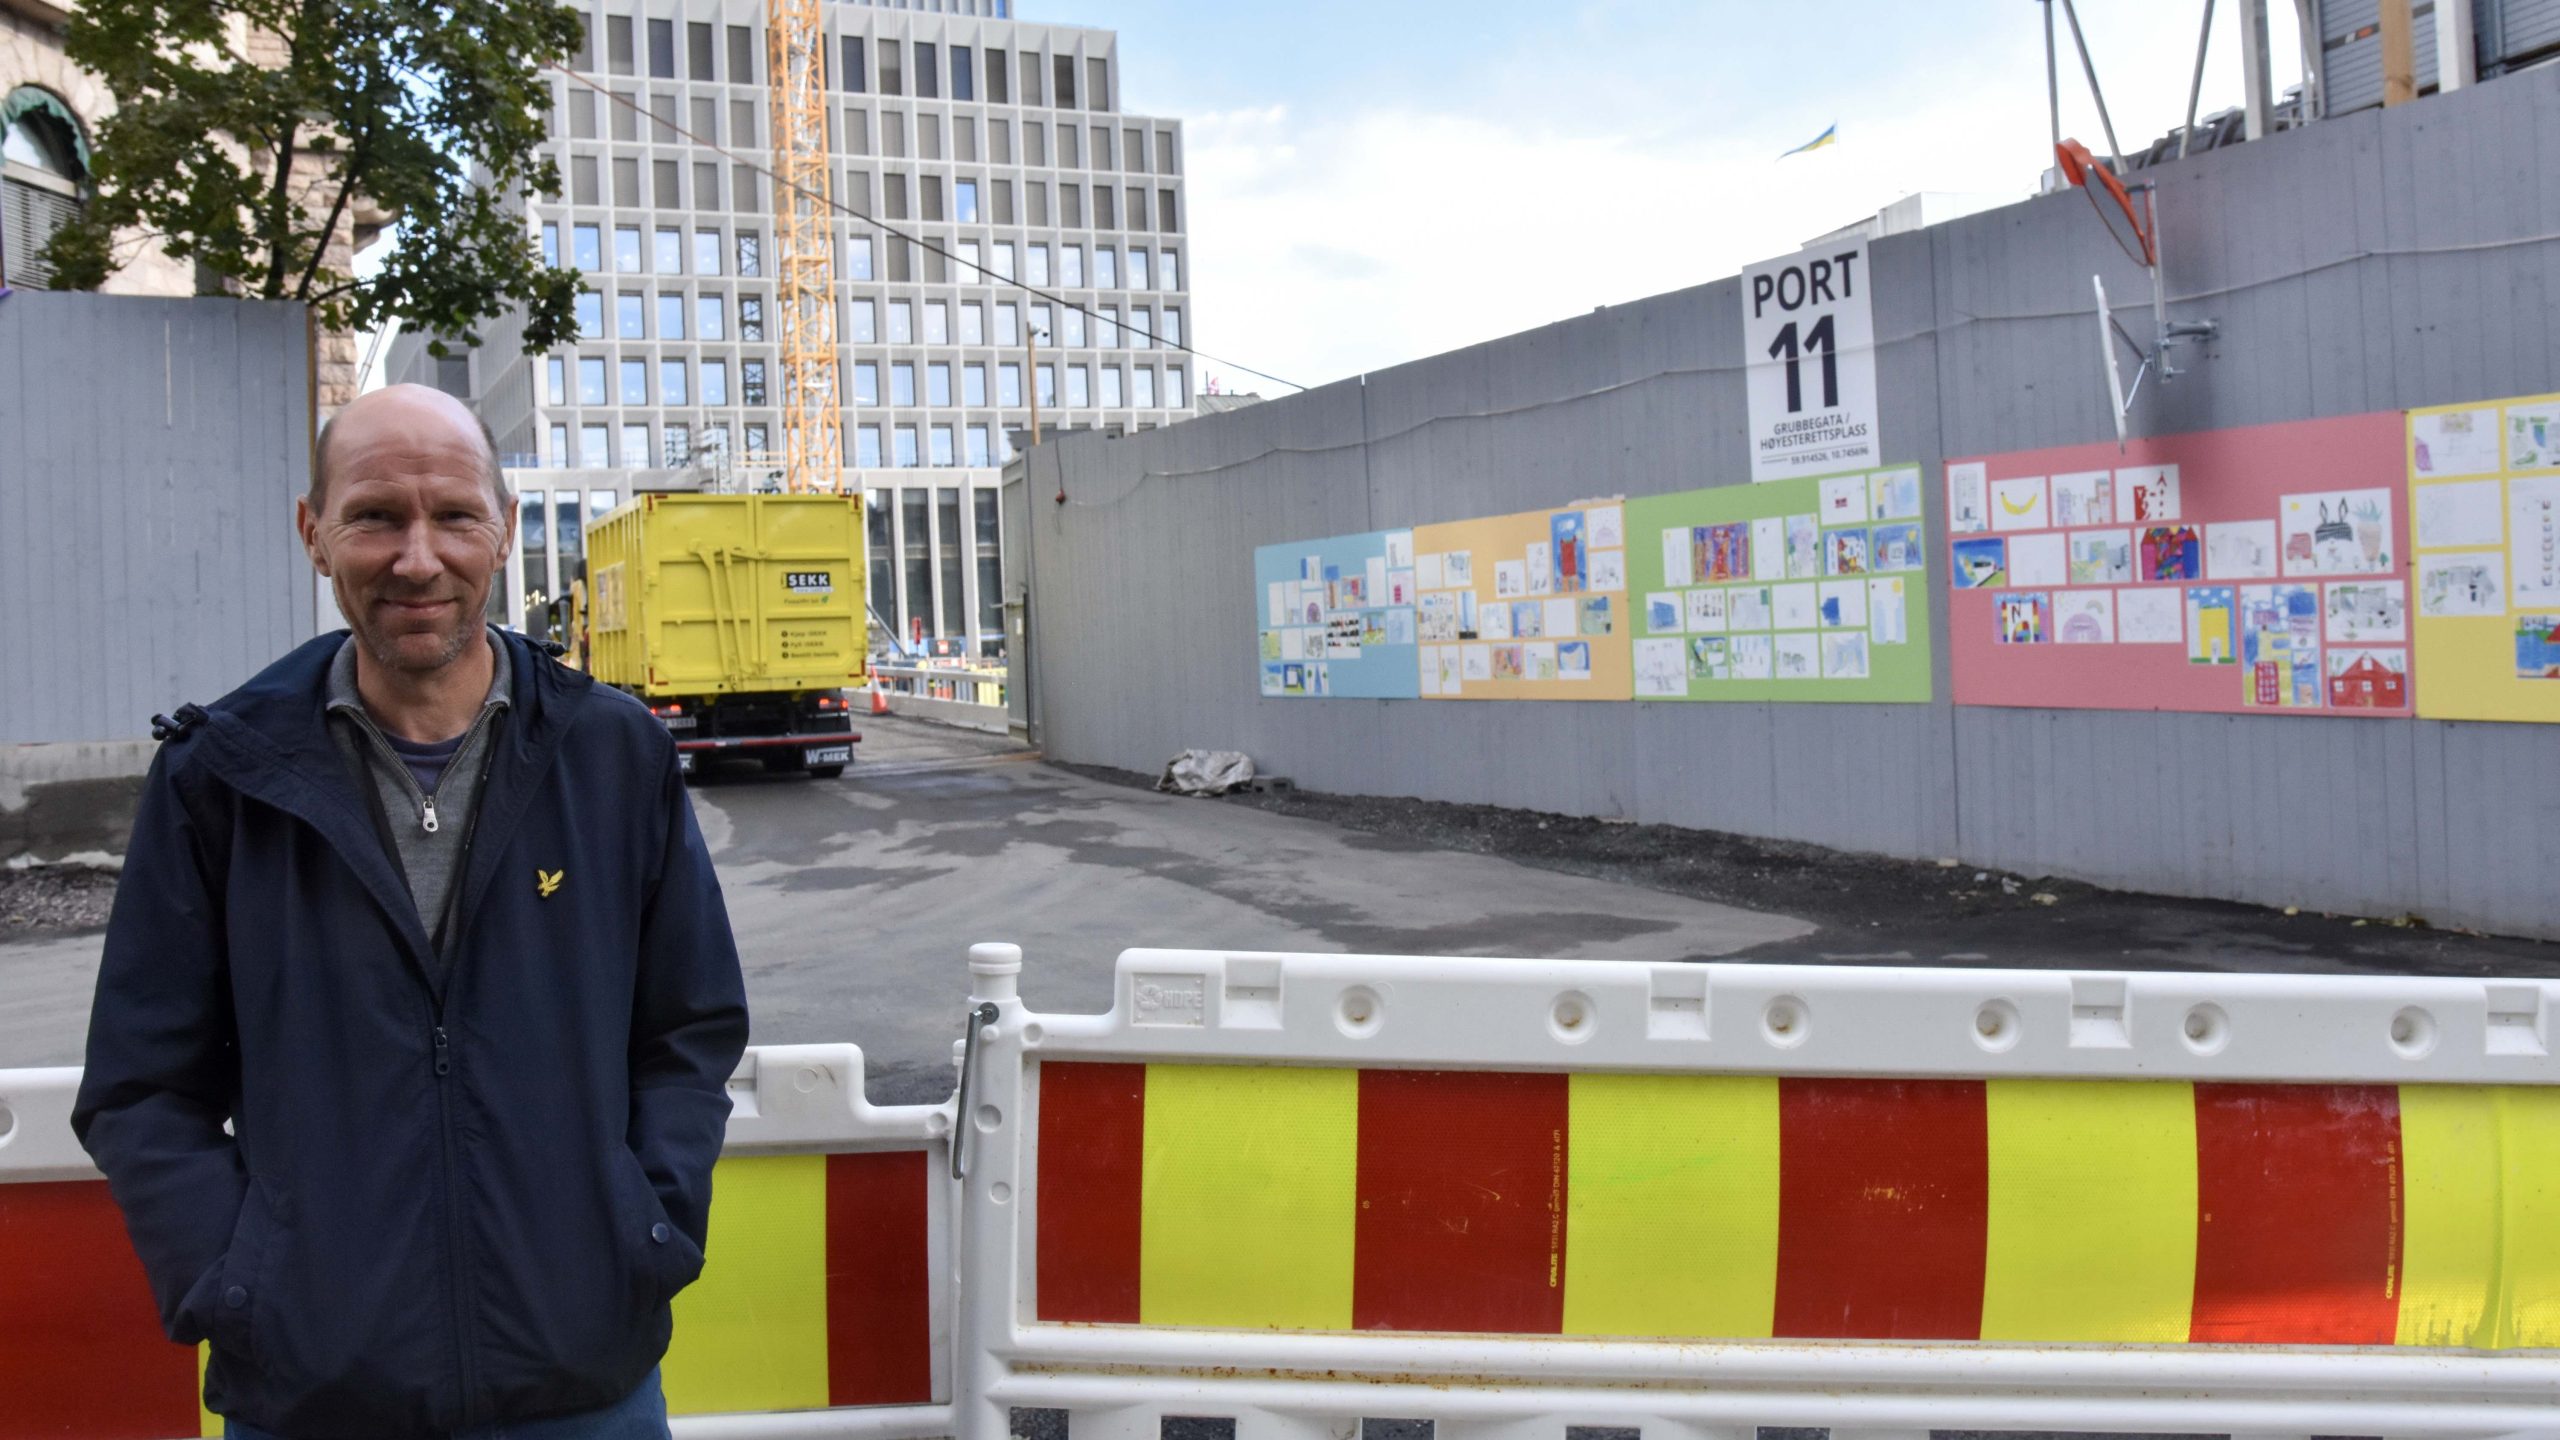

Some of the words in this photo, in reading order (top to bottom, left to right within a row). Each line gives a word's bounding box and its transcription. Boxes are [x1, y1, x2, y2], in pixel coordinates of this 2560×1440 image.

[1753, 250, 1858, 318] PORT
[1768, 314, 1838, 413] 11
[1774, 413, 1843, 435] GRUBBEGATA
[1760, 423, 1867, 450] HØYESTERETTSPLASS
[788, 574, 829, 586] SEKK
[806, 750, 849, 764] W-MEK
